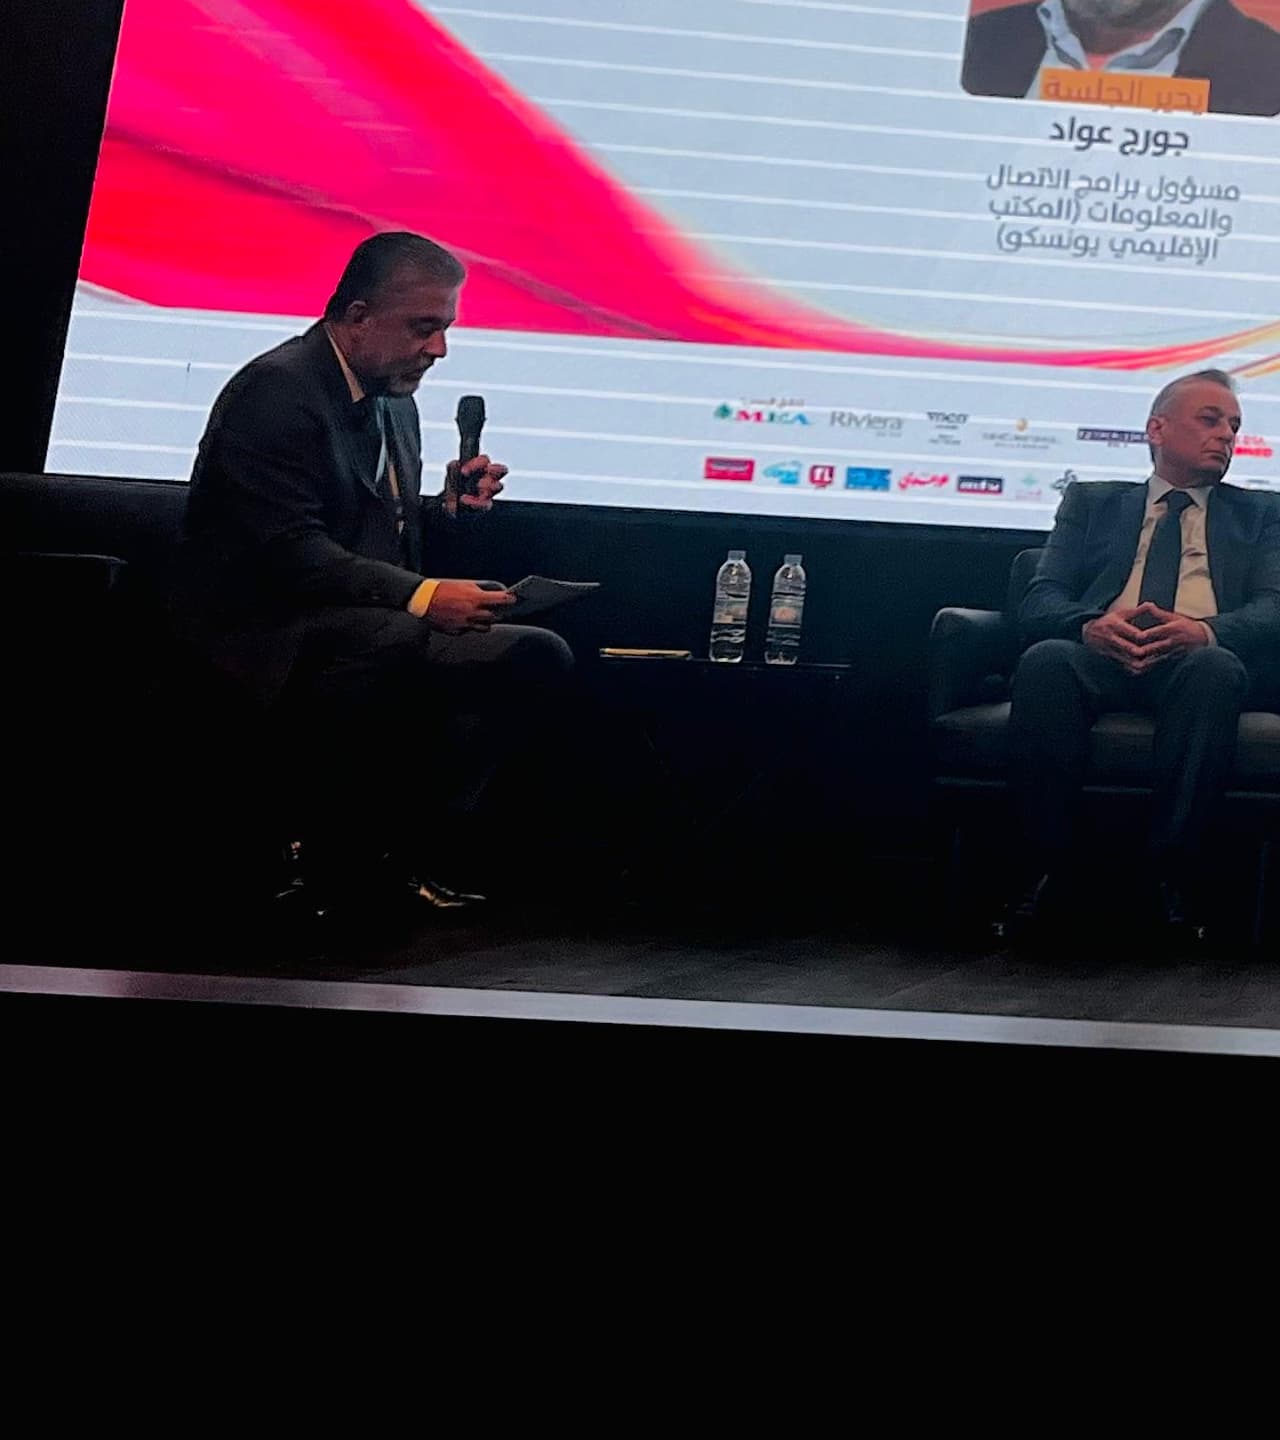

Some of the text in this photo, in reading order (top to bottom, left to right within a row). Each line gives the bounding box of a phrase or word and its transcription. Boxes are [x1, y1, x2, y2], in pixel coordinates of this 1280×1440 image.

[1043, 75, 1143, 109] الجلسة
[1049, 116, 1189, 157] جورج عواد
[986, 164, 1240, 204] مسؤول برامج الاتصال
[989, 197, 1233, 237] والمعلومات (المكتب
[997, 223, 1218, 265] الإقليمي يونسكو)
[830, 411, 903, 431] Riviera
